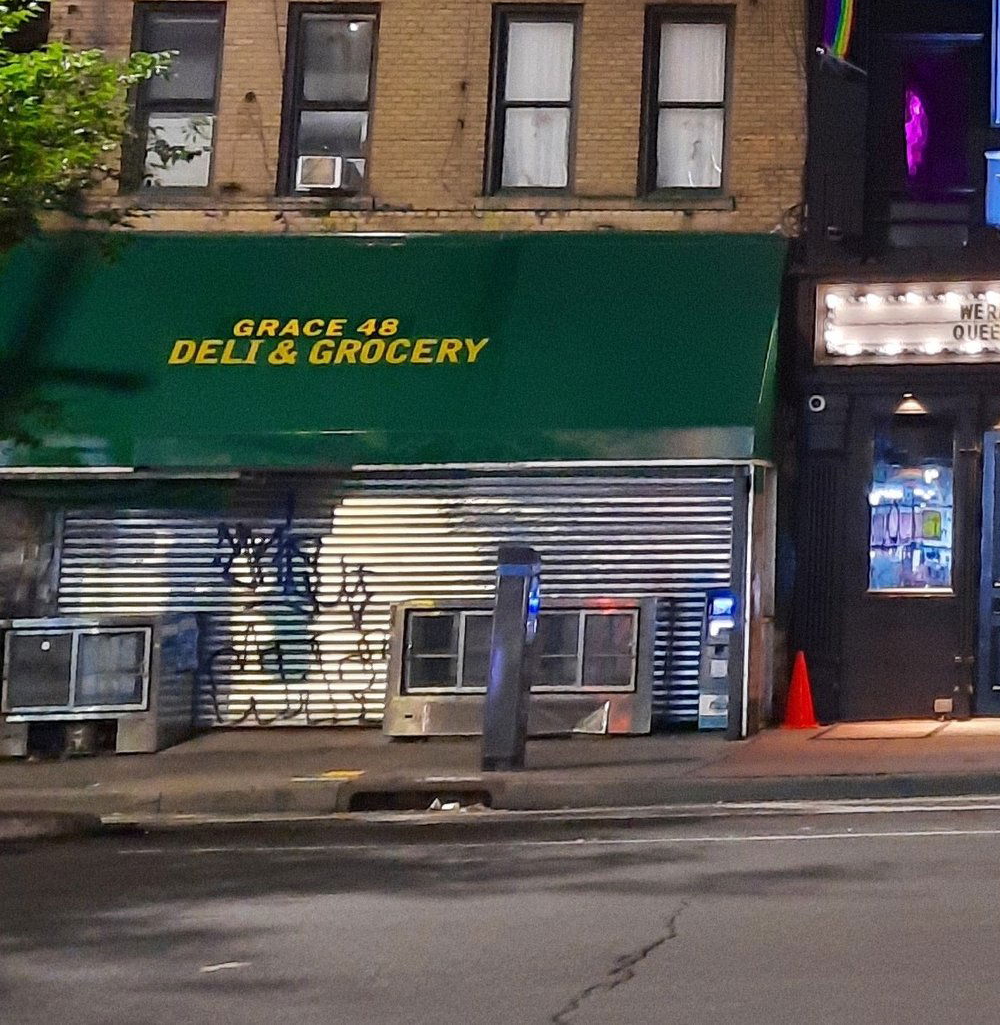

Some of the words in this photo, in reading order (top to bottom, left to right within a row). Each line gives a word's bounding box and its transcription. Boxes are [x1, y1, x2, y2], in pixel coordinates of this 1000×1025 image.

[233, 318, 347, 336] GRACE
[356, 318, 399, 336] 48
[168, 339, 265, 364] DELI
[268, 339, 298, 364] &
[308, 338, 489, 364] GROCERY
